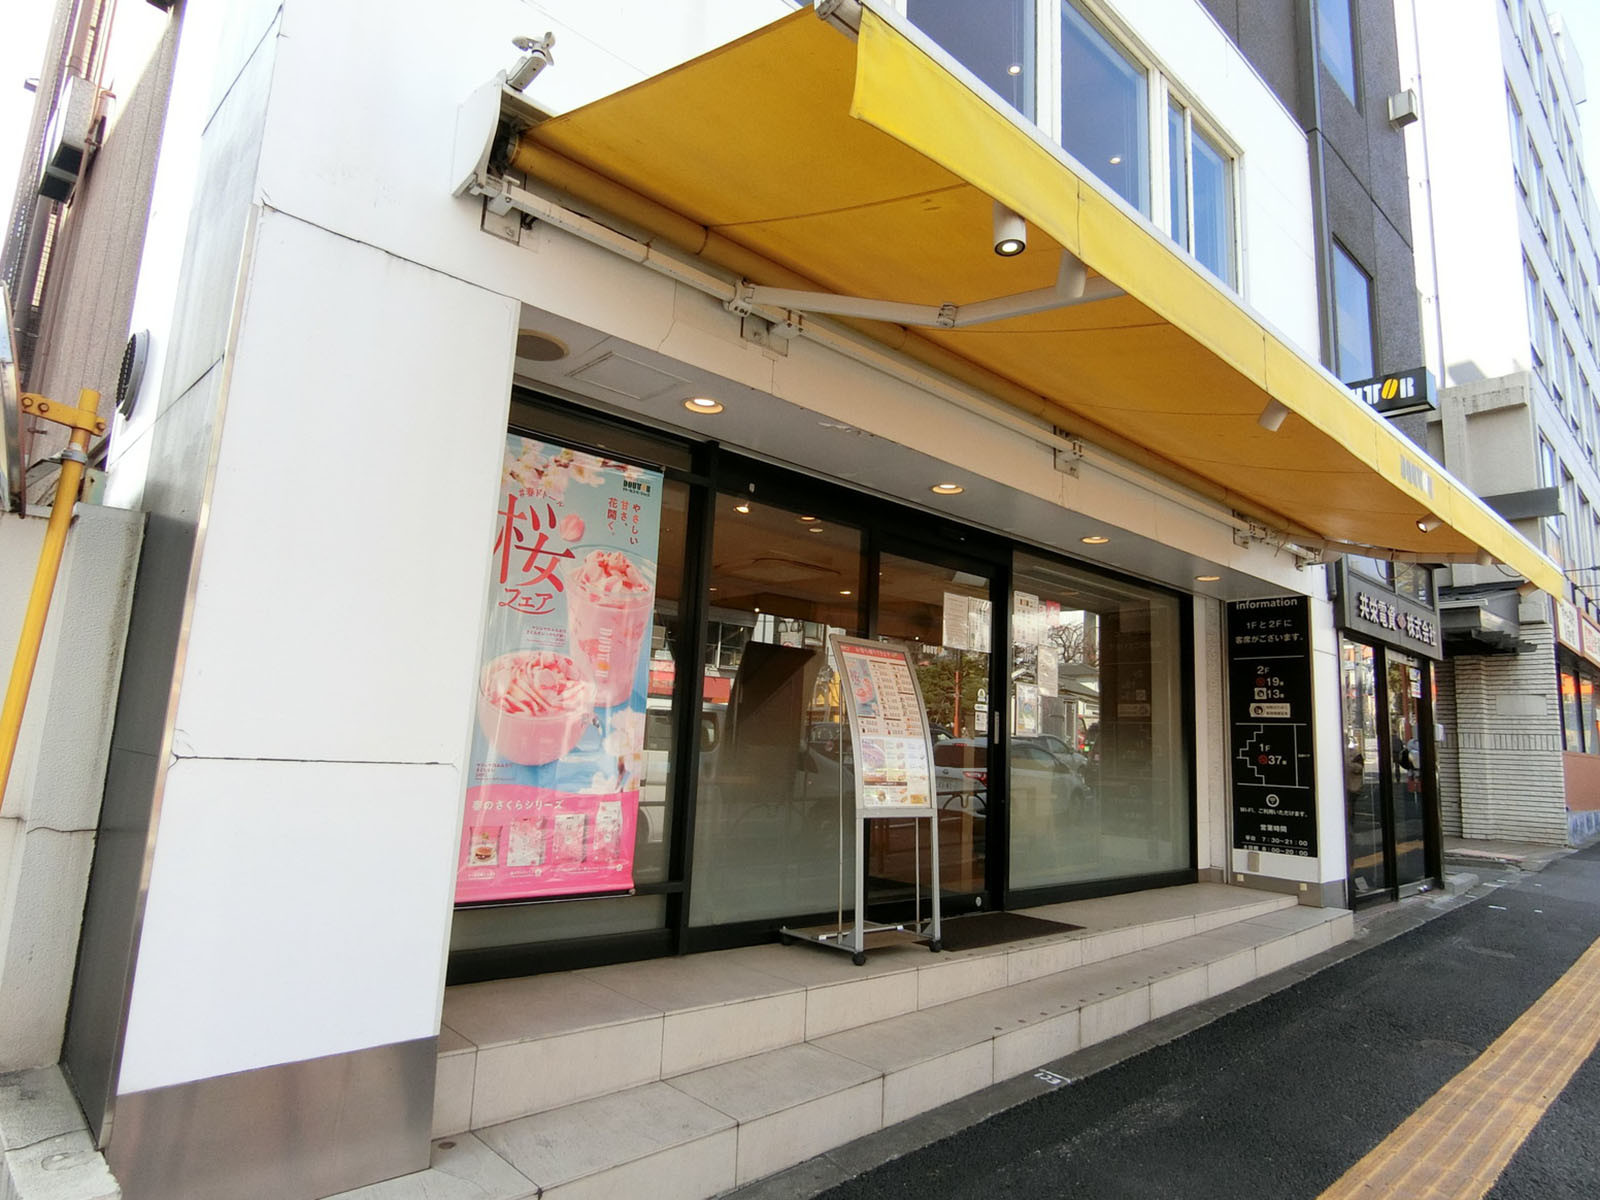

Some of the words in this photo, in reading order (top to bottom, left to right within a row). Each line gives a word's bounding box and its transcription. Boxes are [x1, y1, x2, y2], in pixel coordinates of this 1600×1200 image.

[623, 479, 651, 493] DOUTOR
[629, 503, 641, 545] やさしい
[493, 494, 576, 592] 桜
[498, 587, 556, 615] フェア
[1246, 619, 1294, 629] 1Fと2Fに
[1407, 612, 1437, 646] 株式会社
[1256, 665, 1270, 674] 2F
[1259, 743, 1271, 752] 1F
